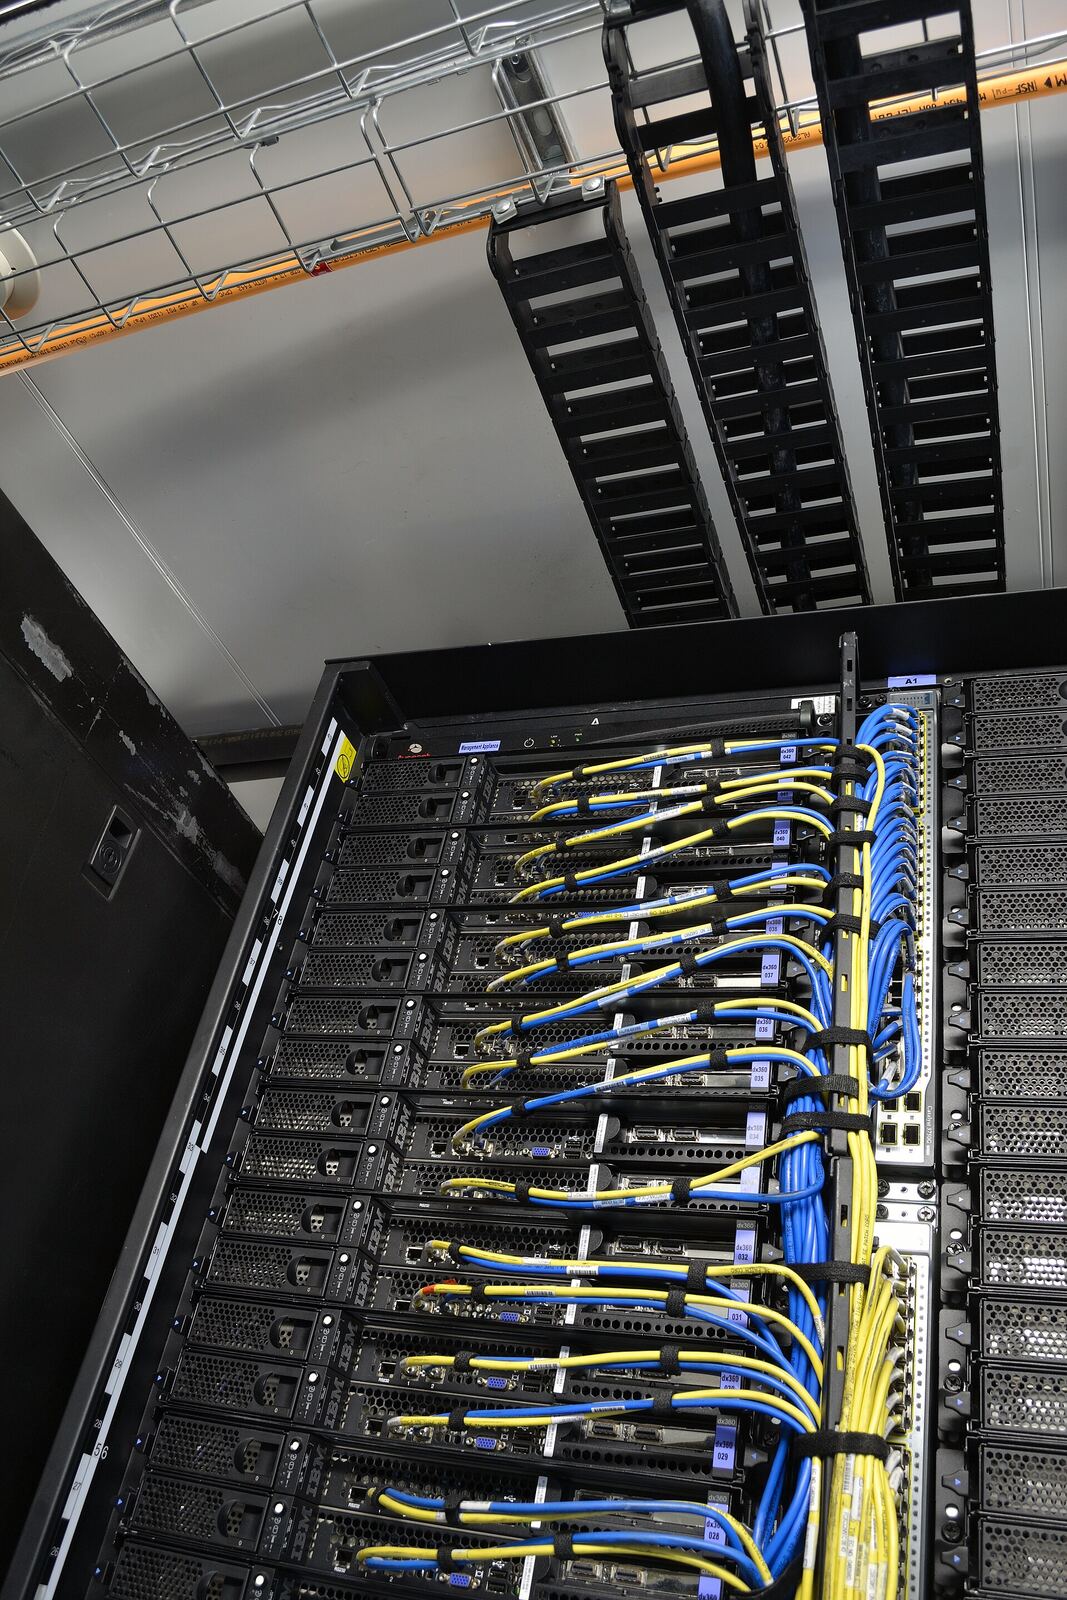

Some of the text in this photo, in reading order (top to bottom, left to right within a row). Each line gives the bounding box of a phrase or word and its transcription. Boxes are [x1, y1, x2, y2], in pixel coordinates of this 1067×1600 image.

[482, 743, 499, 751] Appliance
[443, 922, 457, 962] IBM
[420, 1008, 435, 1052] IBM
[394, 1104, 412, 1150] IBM
[368, 1208, 386, 1256] IBM
[355, 1260, 373, 1307] IBM
[339, 1321, 358, 1372] IBM
[721, 1374, 739, 1382] dx360
[324, 1377, 344, 1429] IBM
[306, 1445, 328, 1498] IBM
[717, 1452, 728, 1460] 029
[290, 1505, 313, 1561] IBM
[708, 1531, 720, 1540] 028
